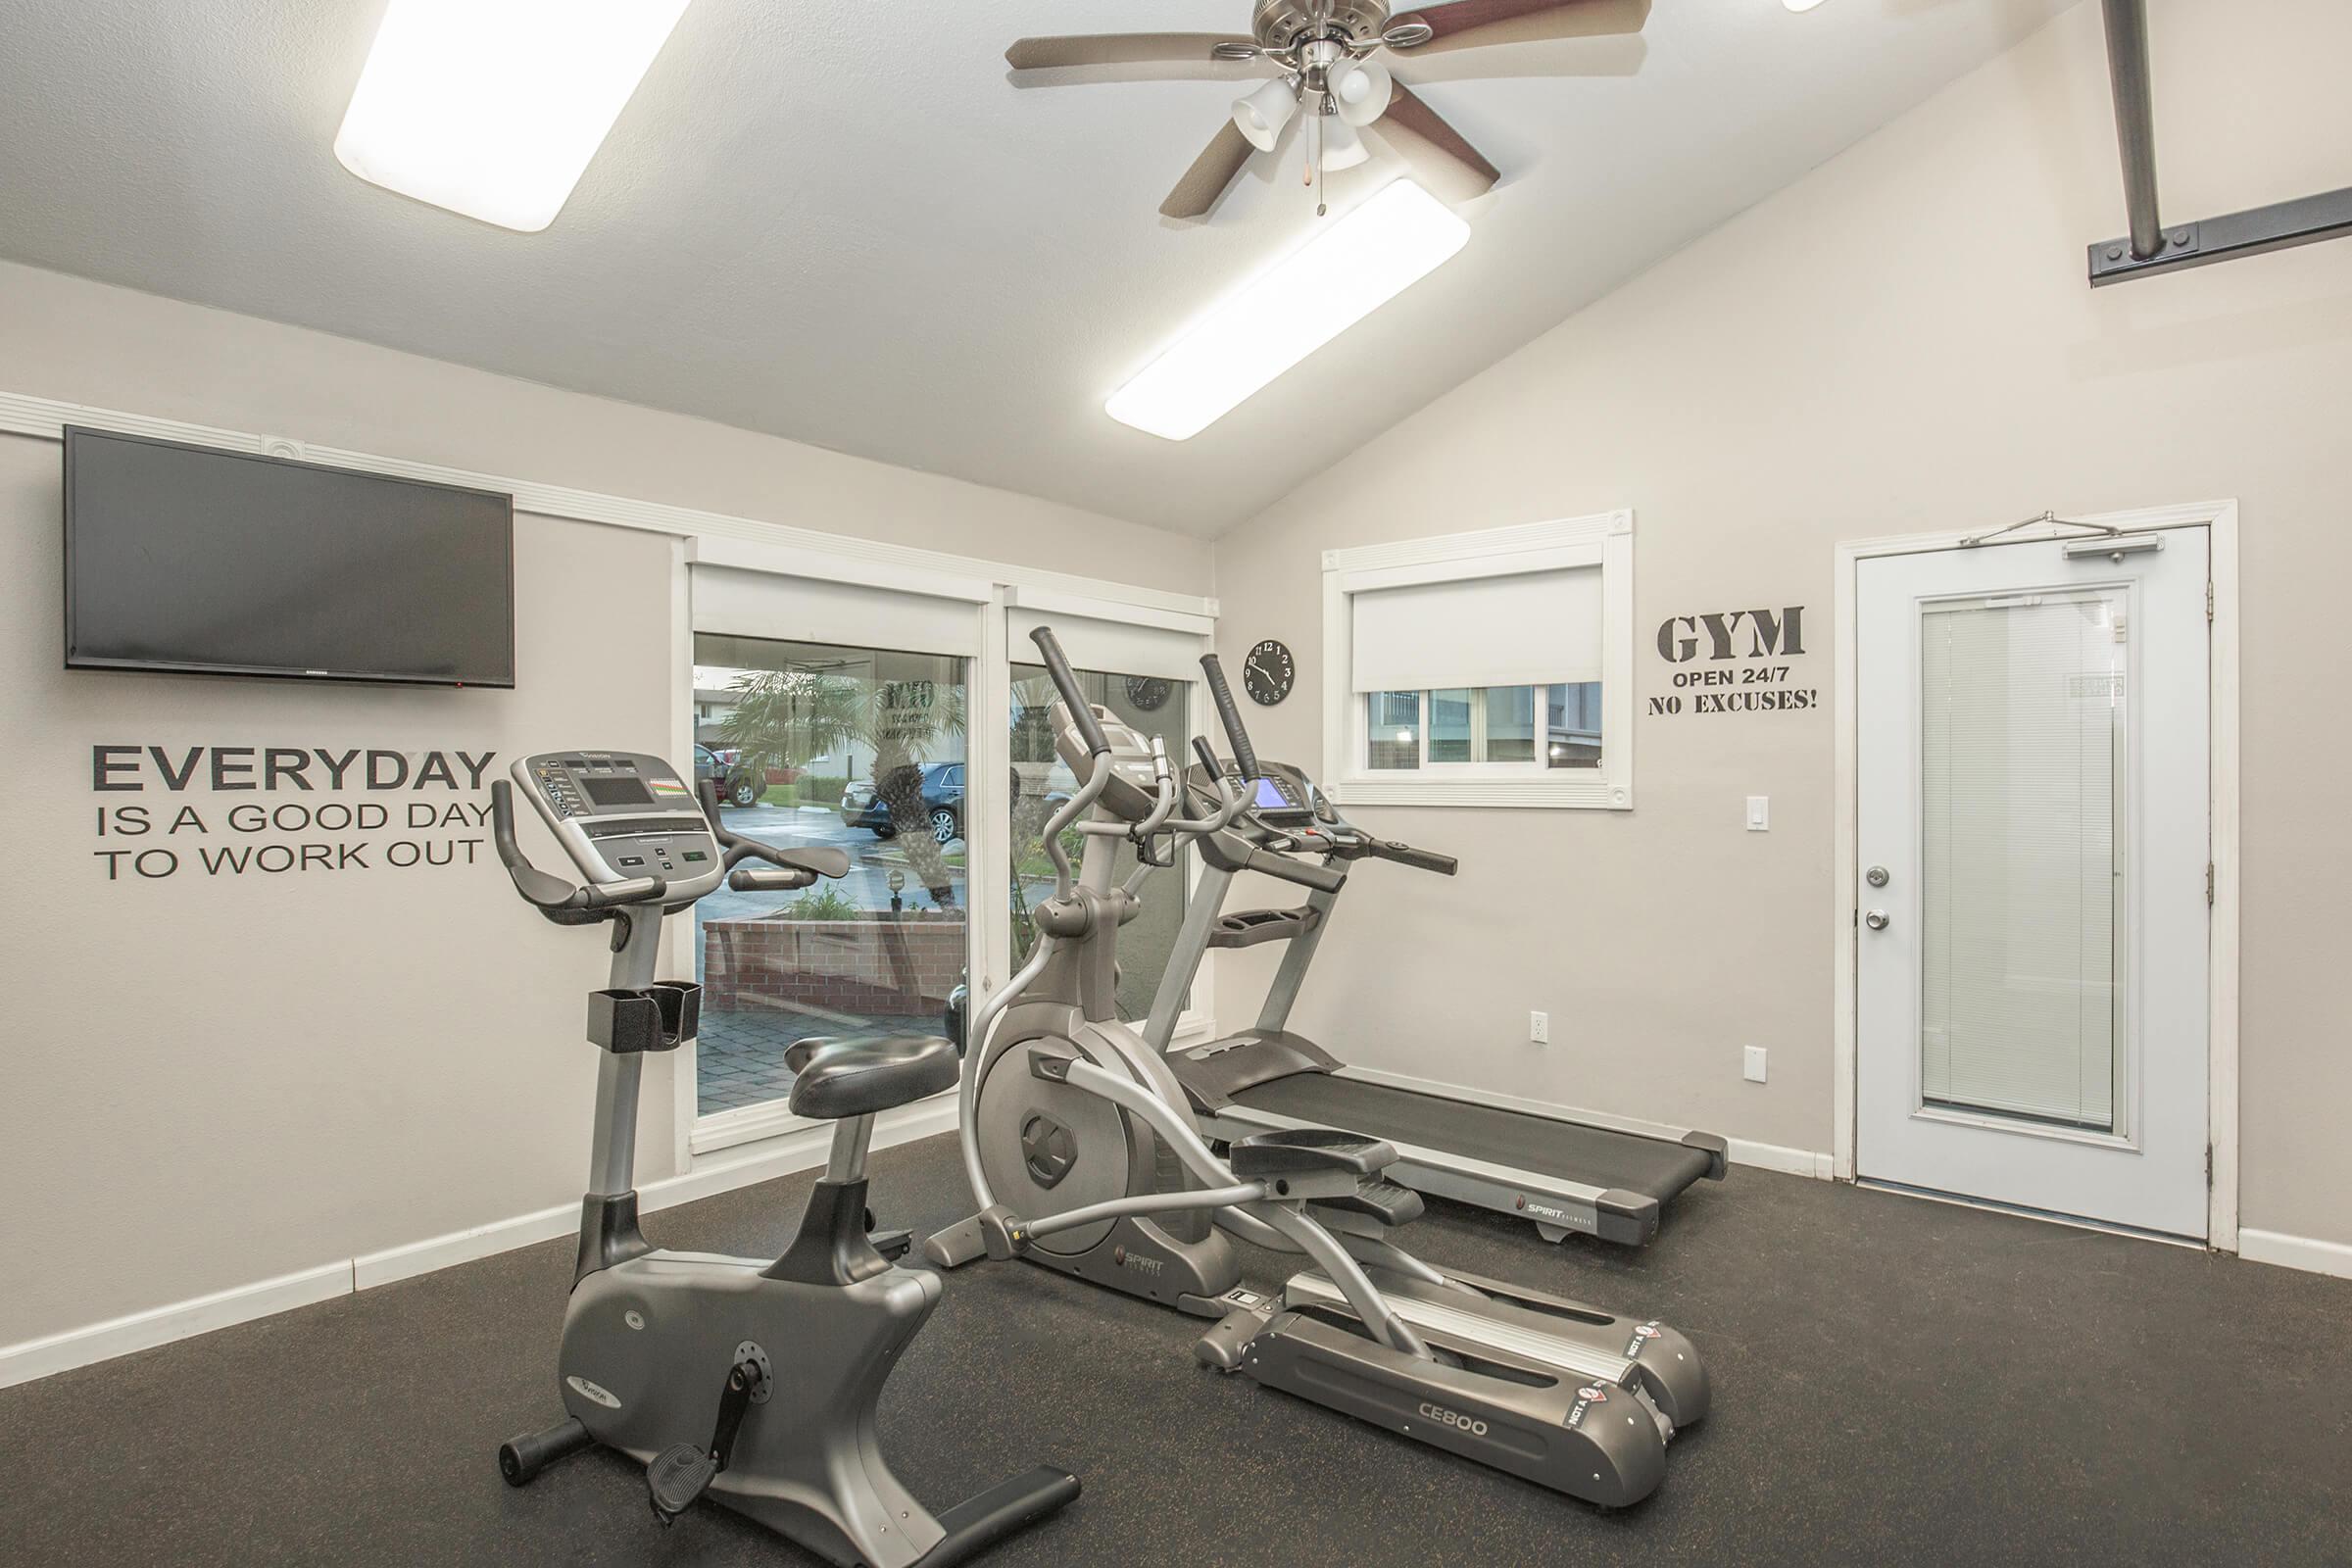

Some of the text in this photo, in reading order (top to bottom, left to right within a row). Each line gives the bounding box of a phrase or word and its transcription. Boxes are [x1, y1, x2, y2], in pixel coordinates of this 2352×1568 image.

[1656, 606, 1806, 663] GYM
[1255, 646, 1262, 656] 11
[1264, 642, 1273, 651] 12
[1276, 646, 1281, 656] 1
[1249, 657, 1256, 665] 10
[1282, 654, 1288, 663] 2
[1245, 668, 1250, 678] 9
[1285, 667, 1291, 677] 3
[1672, 665, 1790, 688] OPEN 24/7
[1248, 680, 1253, 690] 8
[1281, 680, 1287, 690] 4
[1255, 690, 1261, 700] 7
[1264, 693, 1270, 703] 6
[1274, 690, 1280, 700] 5
[1647, 689, 1818, 716] NO EXCUSES!
[92, 745, 497, 792] EVERYDAY
[98, 803, 493, 837] IS A GOOD DAY
[93, 839, 484, 880] TO WORK OUT
[1528, 1203, 1563, 1218] SPIRIT
[1125, 1252, 1164, 1271] SPIRIT
[1418, 1402, 1488, 1436] CE800
[1568, 1404, 1584, 1425] NOT
